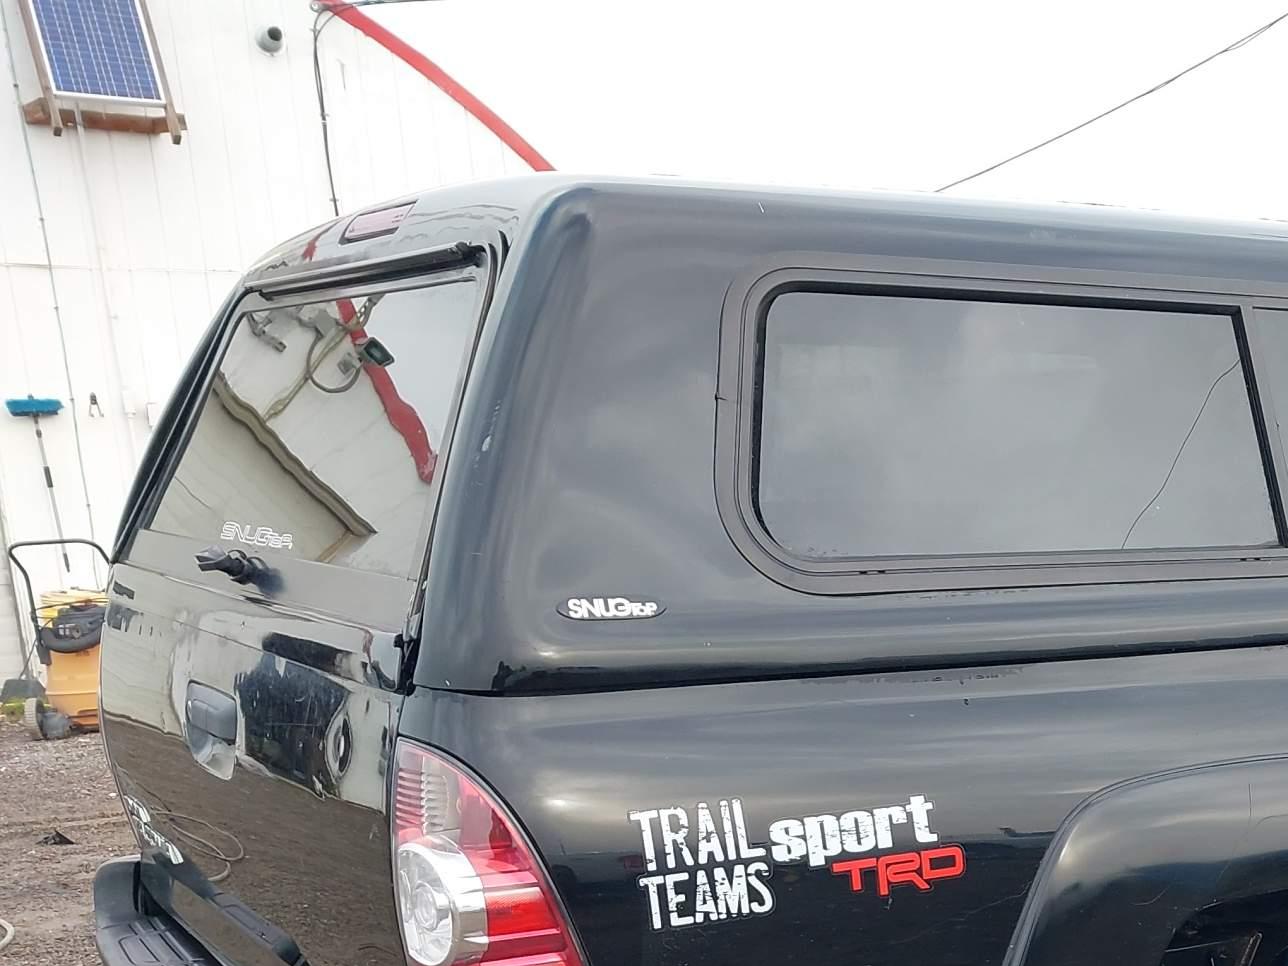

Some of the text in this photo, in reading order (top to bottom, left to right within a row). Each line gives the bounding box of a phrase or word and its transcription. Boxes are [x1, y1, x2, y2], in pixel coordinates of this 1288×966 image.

[628, 794, 939, 872] TRAIL sport
[639, 861, 774, 930] TEAMS
[832, 845, 966, 896] TRD
